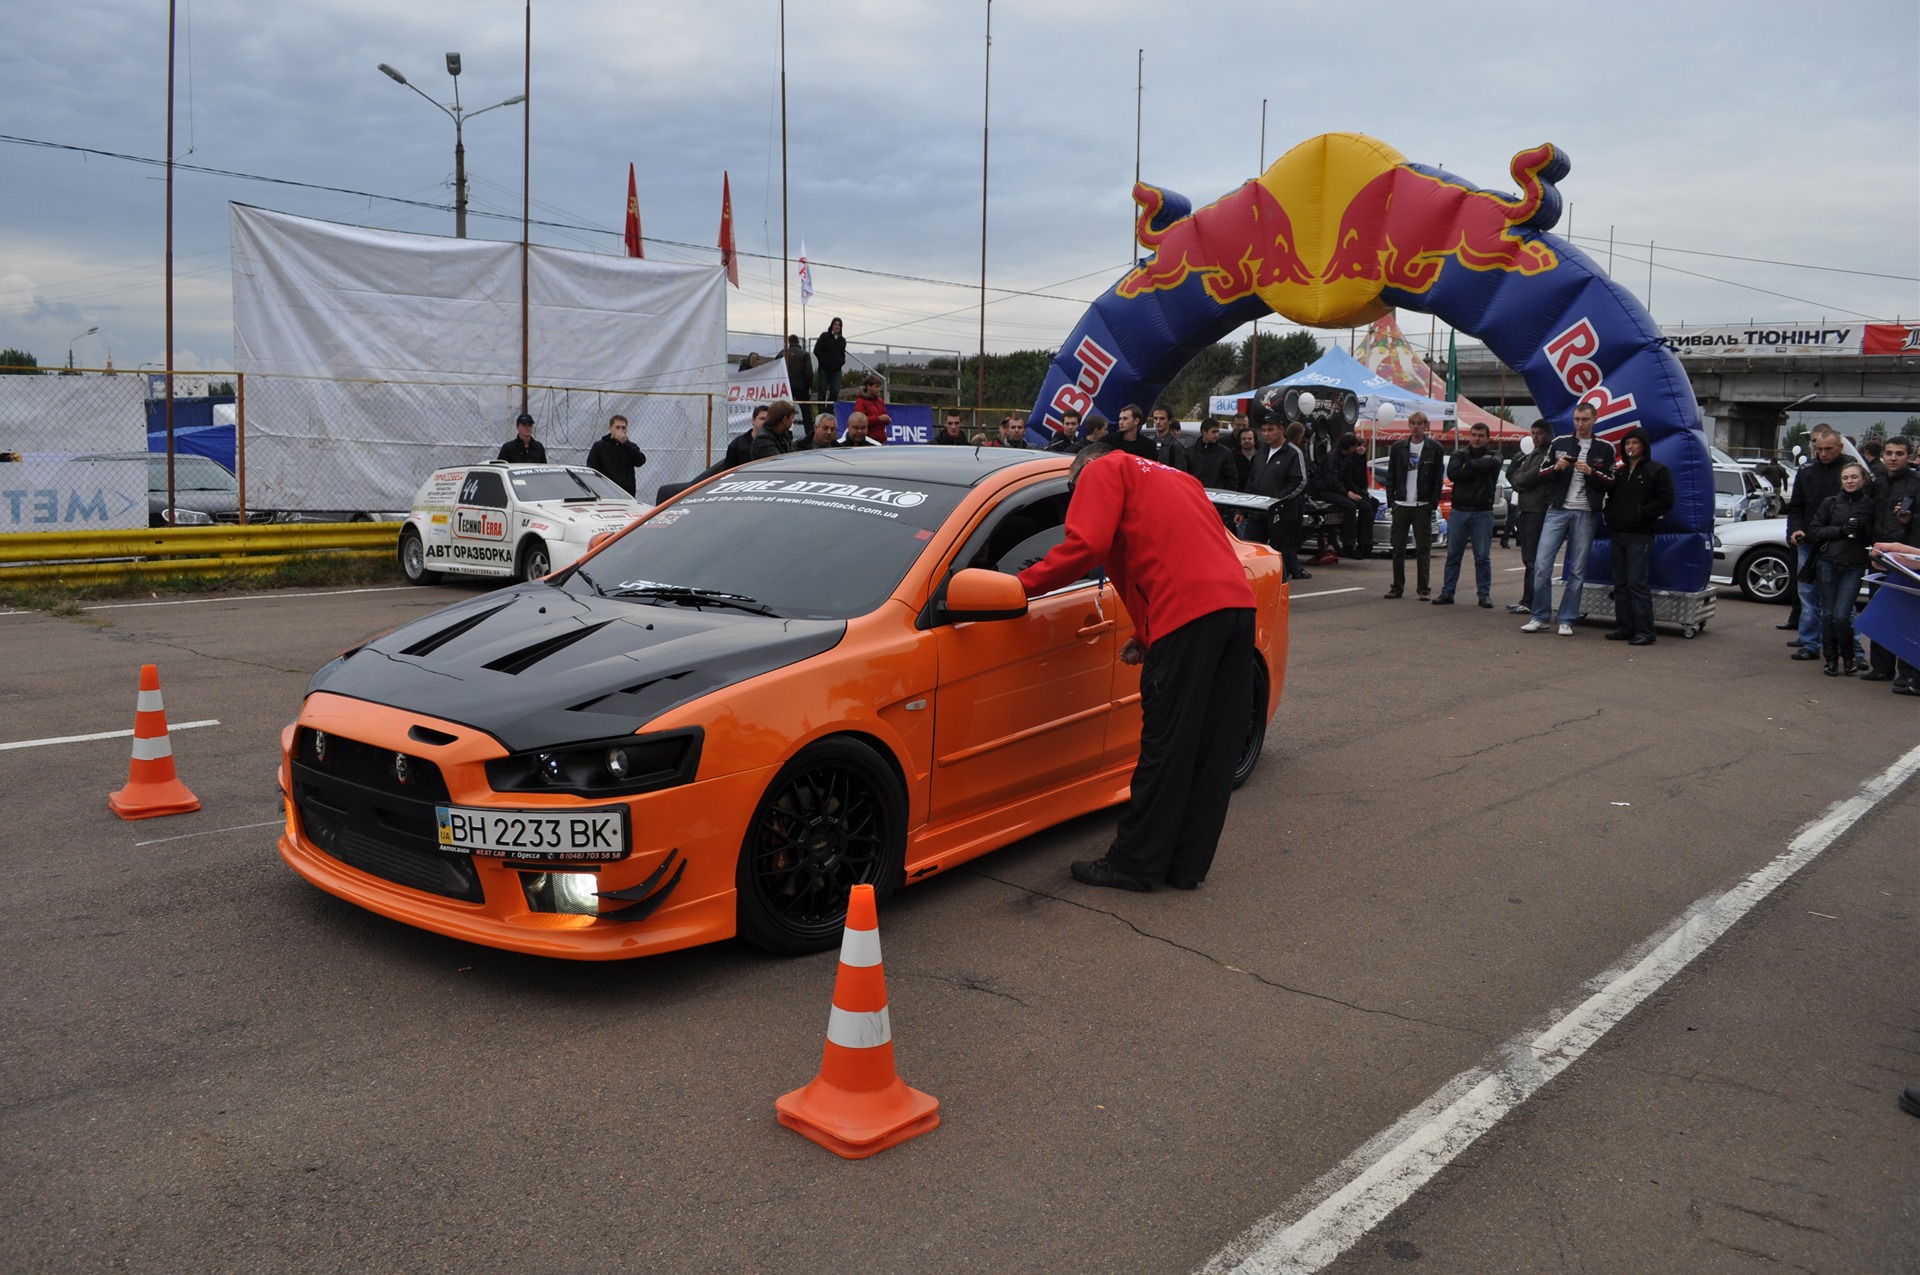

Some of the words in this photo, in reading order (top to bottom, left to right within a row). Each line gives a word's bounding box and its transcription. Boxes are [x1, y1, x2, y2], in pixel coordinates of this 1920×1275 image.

[1664, 335, 1739, 347] тиваль
[1743, 328, 1850, 345] ТЮНІНГУ
[1051, 335, 1117, 424] Bull
[1543, 317, 1637, 424] Red
[463, 479, 479, 500] 44
[706, 480, 786, 495] TIME
[778, 480, 903, 504] ATTACK
[680, 496, 706, 505] Catch
[733, 495, 764, 503] action
[776, 496, 899, 519] www.timeattack.com.ua
[458, 512, 502, 536] TECHNOTERRA
[440, 831, 450, 841] UA
[450, 814, 487, 844] BH
[494, 818, 561, 848] 2233
[570, 818, 612, 848] BK
[586, 851, 599, 859] 703
